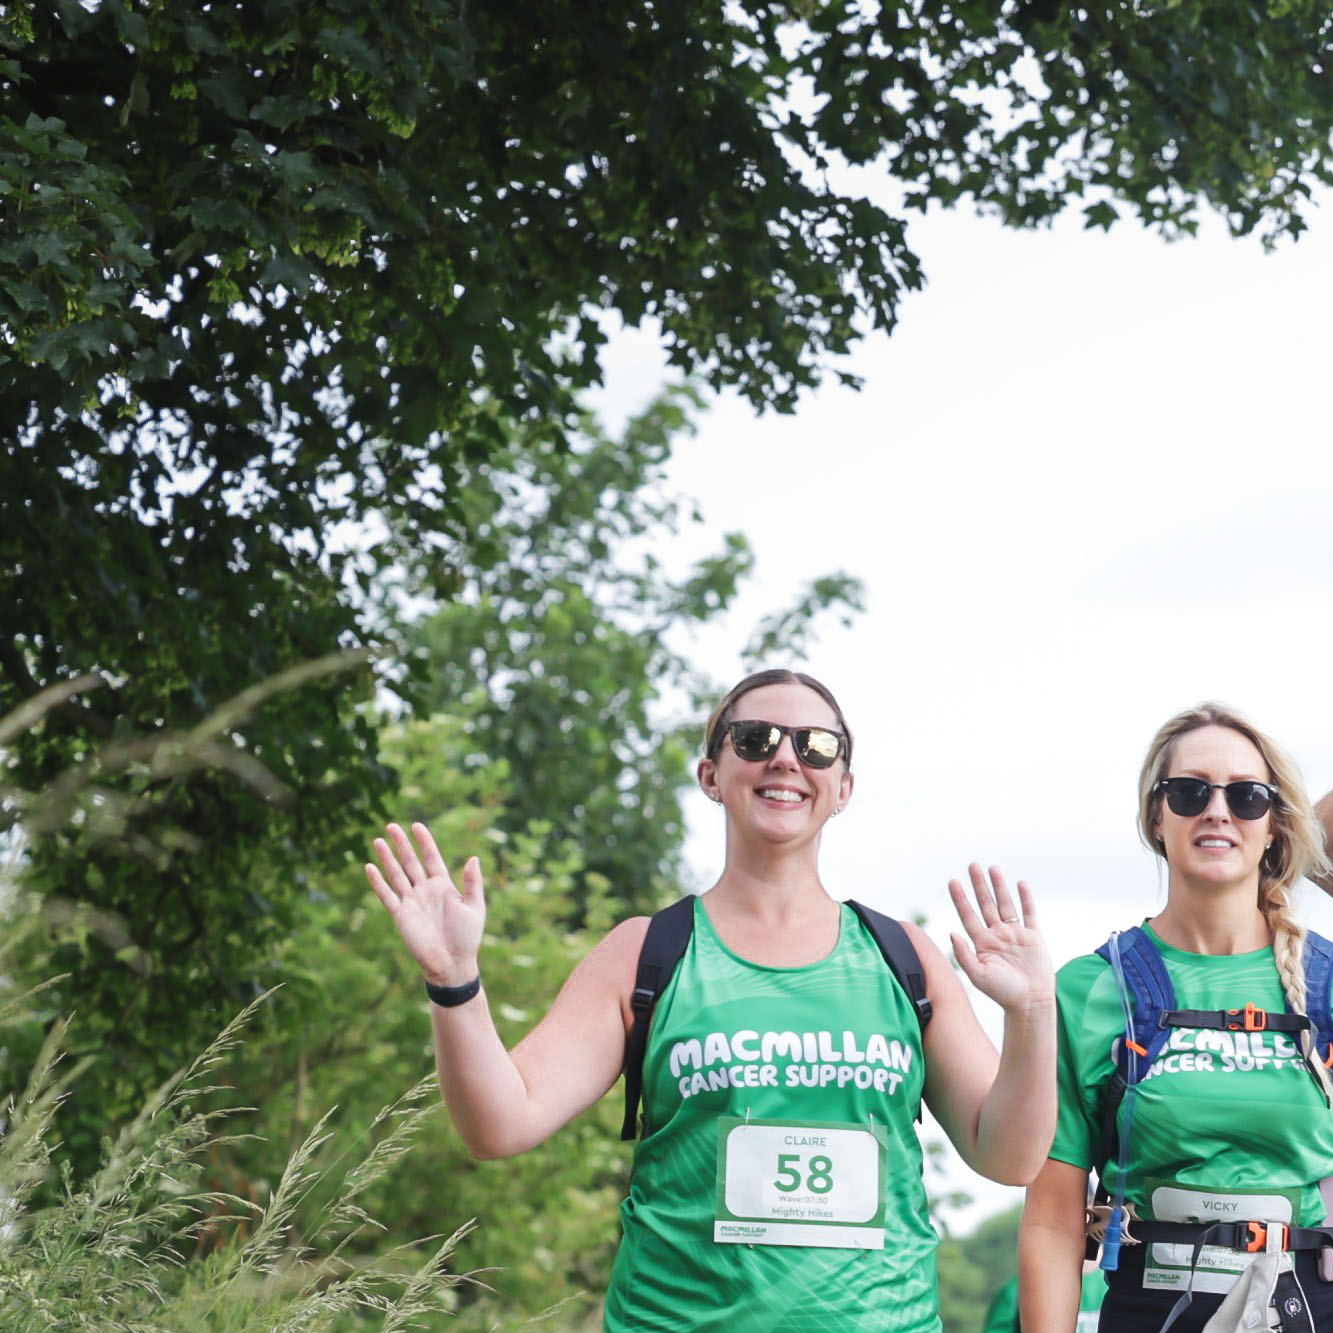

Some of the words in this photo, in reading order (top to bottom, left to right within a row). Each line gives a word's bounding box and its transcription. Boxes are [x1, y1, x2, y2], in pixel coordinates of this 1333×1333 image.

[669, 1030, 912, 1078] MACMILLAN
[1140, 1052, 1215, 1083] NCER
[678, 1064, 779, 1099] CANCER
[785, 1064, 903, 1096] SUPPORT
[784, 1136, 827, 1147] CLAIRE
[773, 1153, 834, 1194] 58
[772, 1207, 805, 1217] Mighty
[807, 1208, 834, 1218] Hikes
[1203, 1200, 1239, 1212] VICKY
[1186, 1255, 1216, 1266] Mghty
[1220, 1257, 1244, 1268] Hikes
